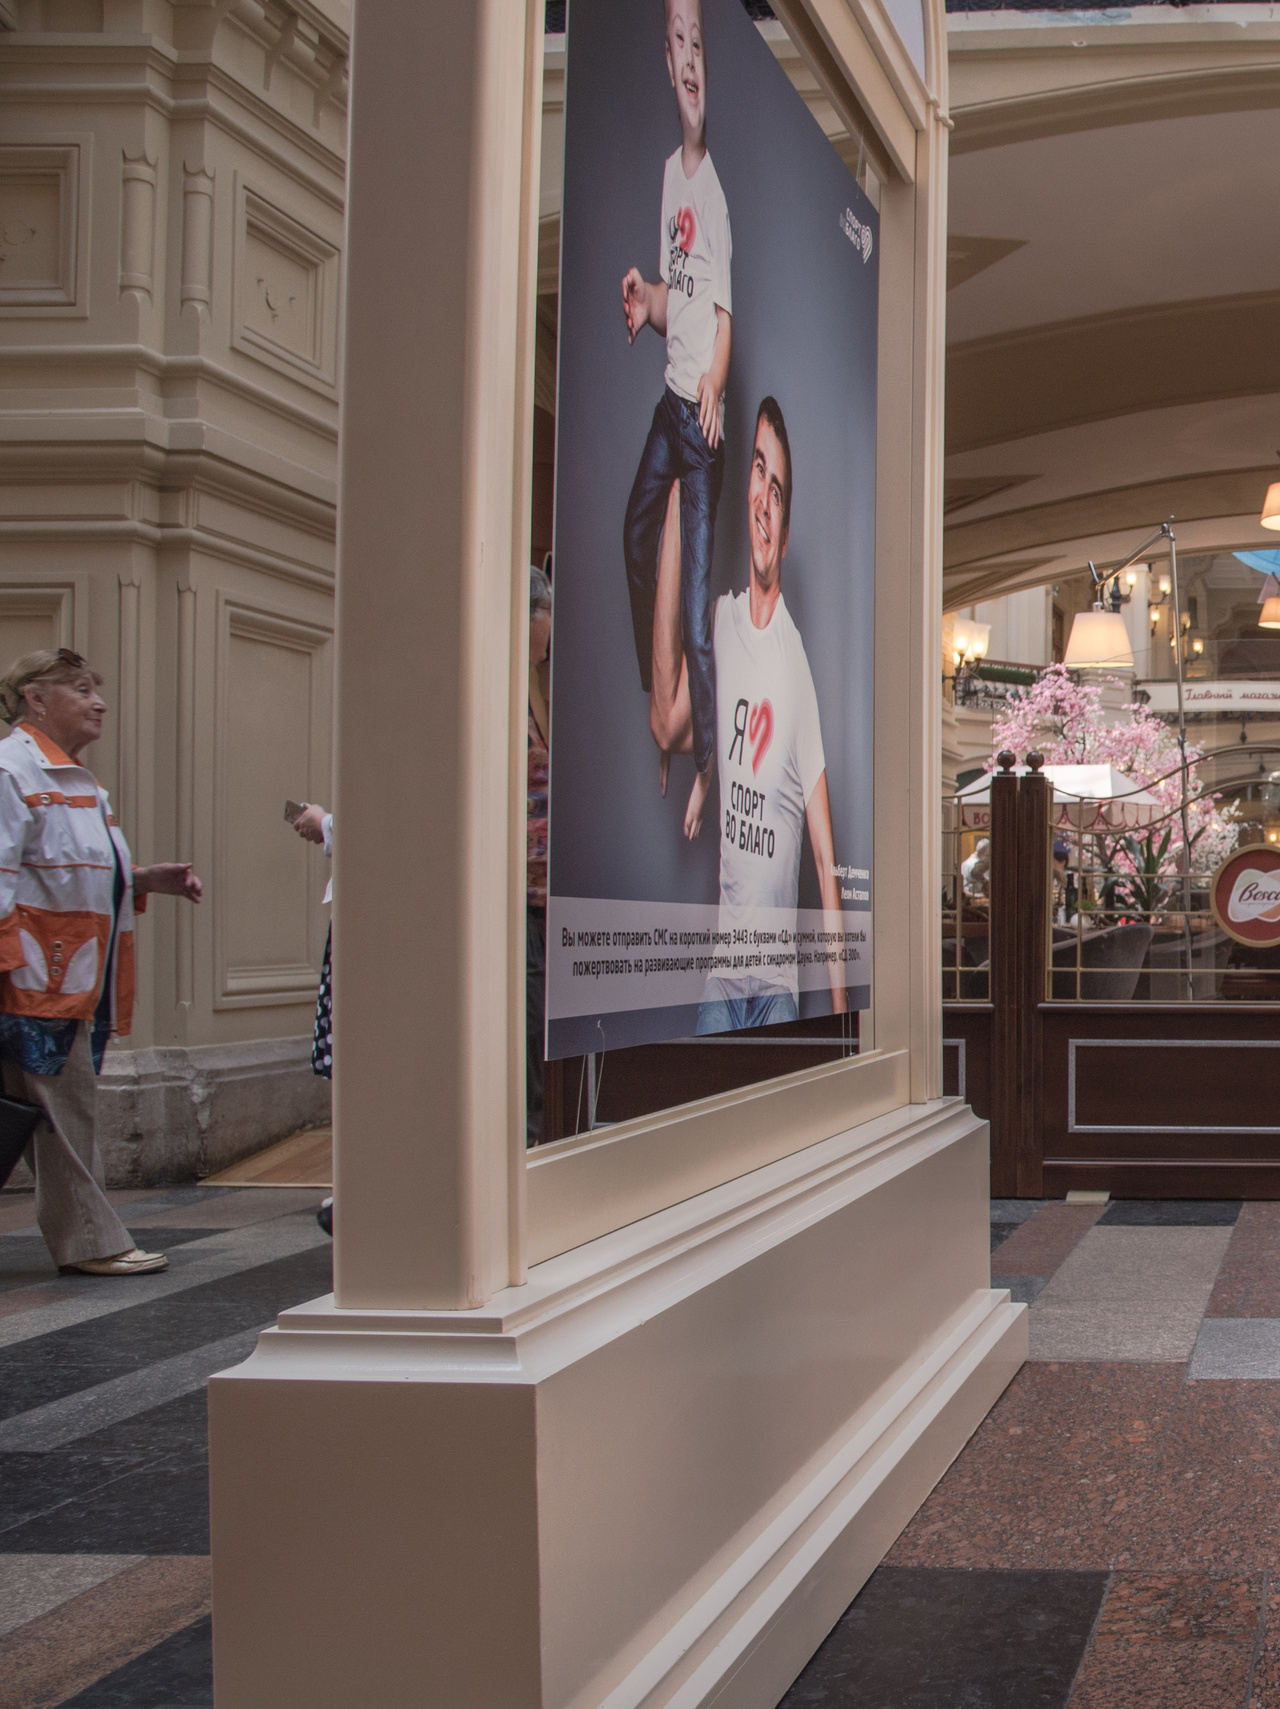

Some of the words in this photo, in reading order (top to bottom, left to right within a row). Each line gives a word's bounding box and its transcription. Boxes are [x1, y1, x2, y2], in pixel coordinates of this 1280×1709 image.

[1184, 688, 1233, 701] Главный
[728, 698, 750, 766] Я
[730, 780, 766, 821] СПОРТ
[725, 809, 737, 844] ВО
[738, 820, 776, 859] БЛАГО
[562, 927, 575, 947] Вы
[577, 931, 611, 947] можете
[612, 931, 652, 950] отправить
[653, 928, 668, 945] СМС
[669, 932, 678, 946] на
[680, 928, 711, 949] короткий
[711, 932, 731, 948] номер
[733, 928, 748, 945] 3443
[753, 929, 777, 947] буквами
[777, 929, 792, 945] «СД»
[797, 929, 816, 946] суммой,
[817, 932, 837, 946] которую
[837, 932, 843, 942] вы
[860, 930, 867, 942] бы
[572, 959, 632, 979] пожертвовать
[633, 959, 643, 973] на
[644, 957, 694, 977] развивающие
[695, 955, 732, 974] программы
[732, 954, 744, 970] для
[745, 951, 762, 969] детей
[767, 953, 797, 969] синдромом
